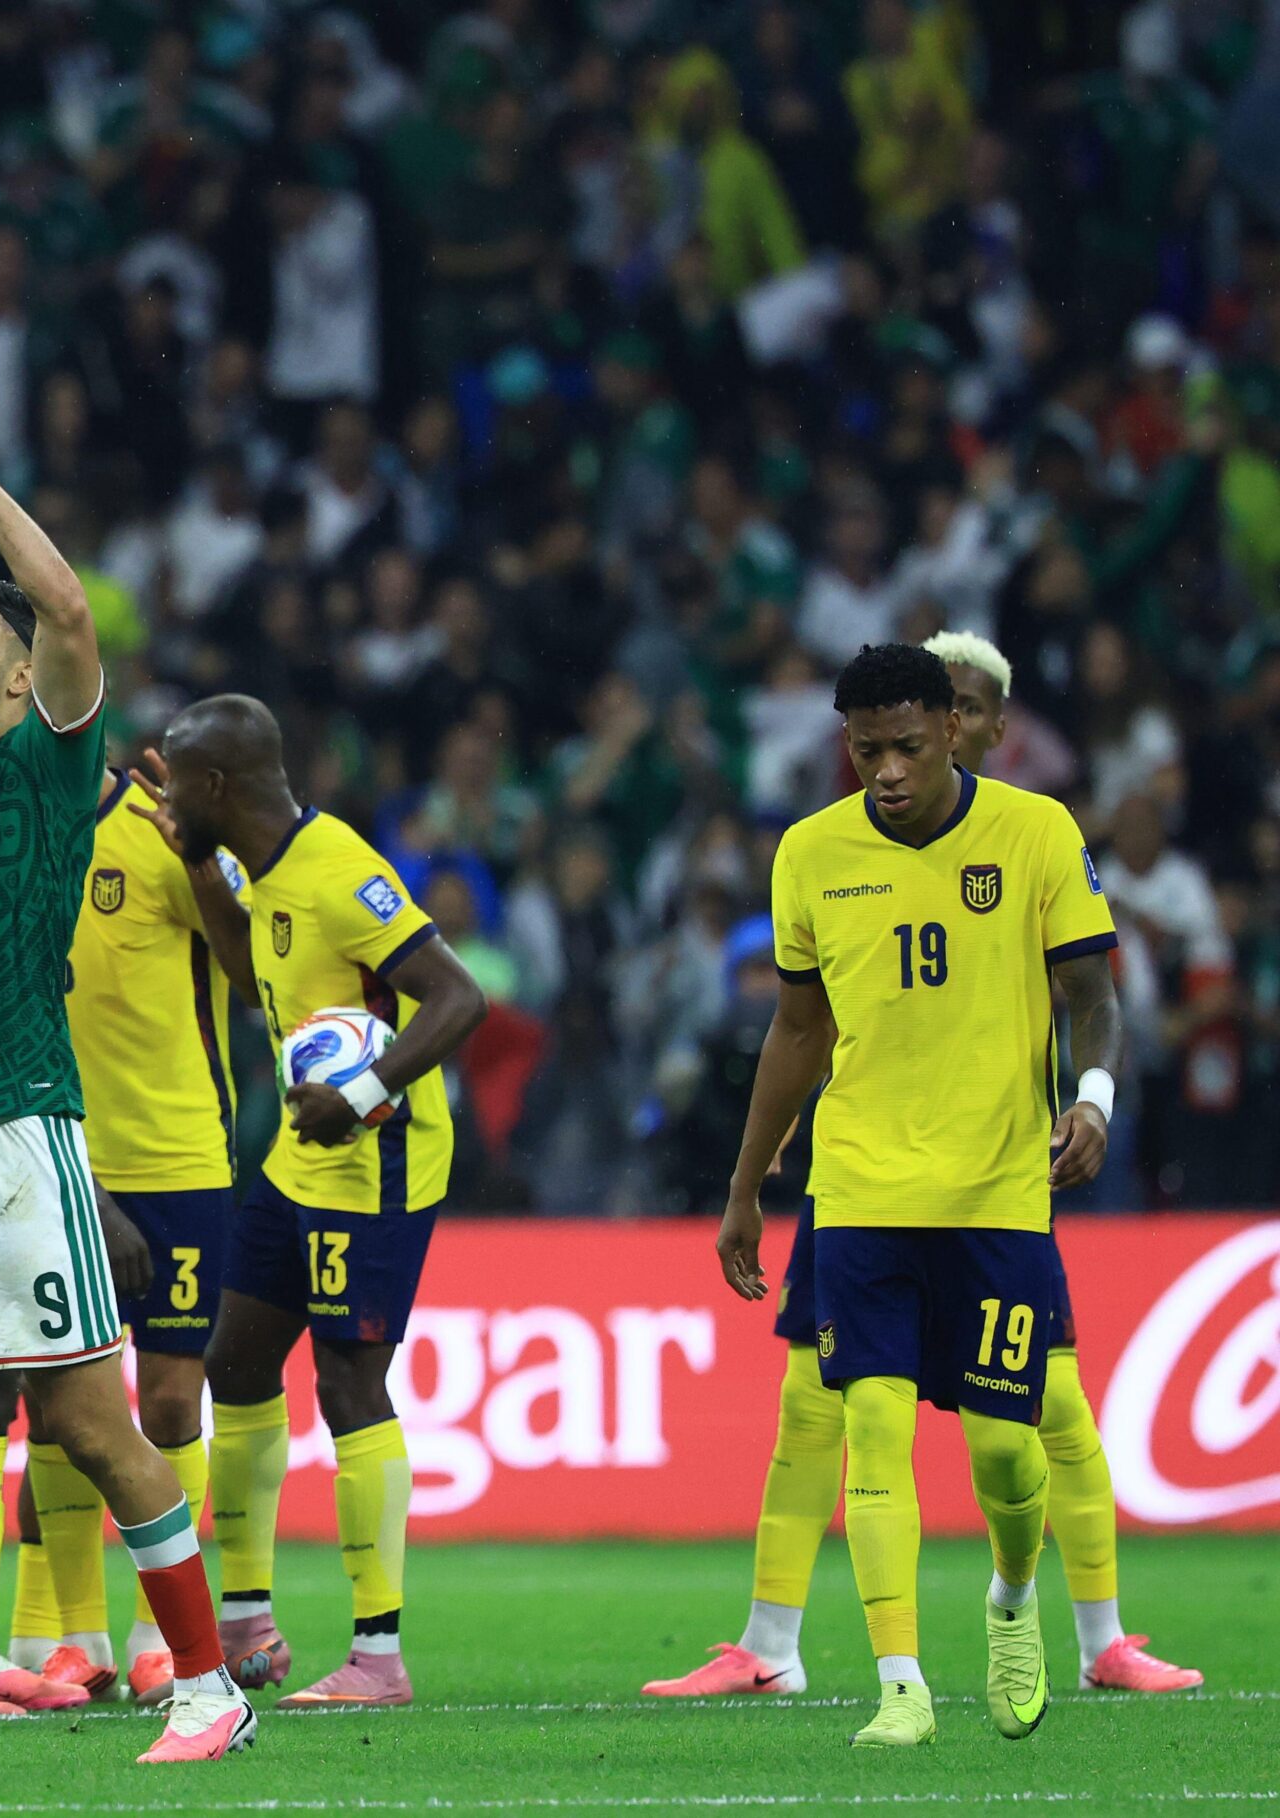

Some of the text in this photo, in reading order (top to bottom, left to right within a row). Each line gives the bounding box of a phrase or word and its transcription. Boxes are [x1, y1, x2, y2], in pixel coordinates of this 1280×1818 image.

[823, 882, 893, 900] marathon
[893, 922, 948, 989] 19
[170, 1247, 200, 1311] 3
[307, 1231, 351, 1296] 13
[33, 1271, 71, 1339] 9
[146, 1315, 209, 1328] marathon
[977, 1298, 1034, 1371] 19
[210, 1306, 717, 1517] gar
[964, 1371, 1030, 1396] marathon
[847, 1487, 889, 1496] athon
